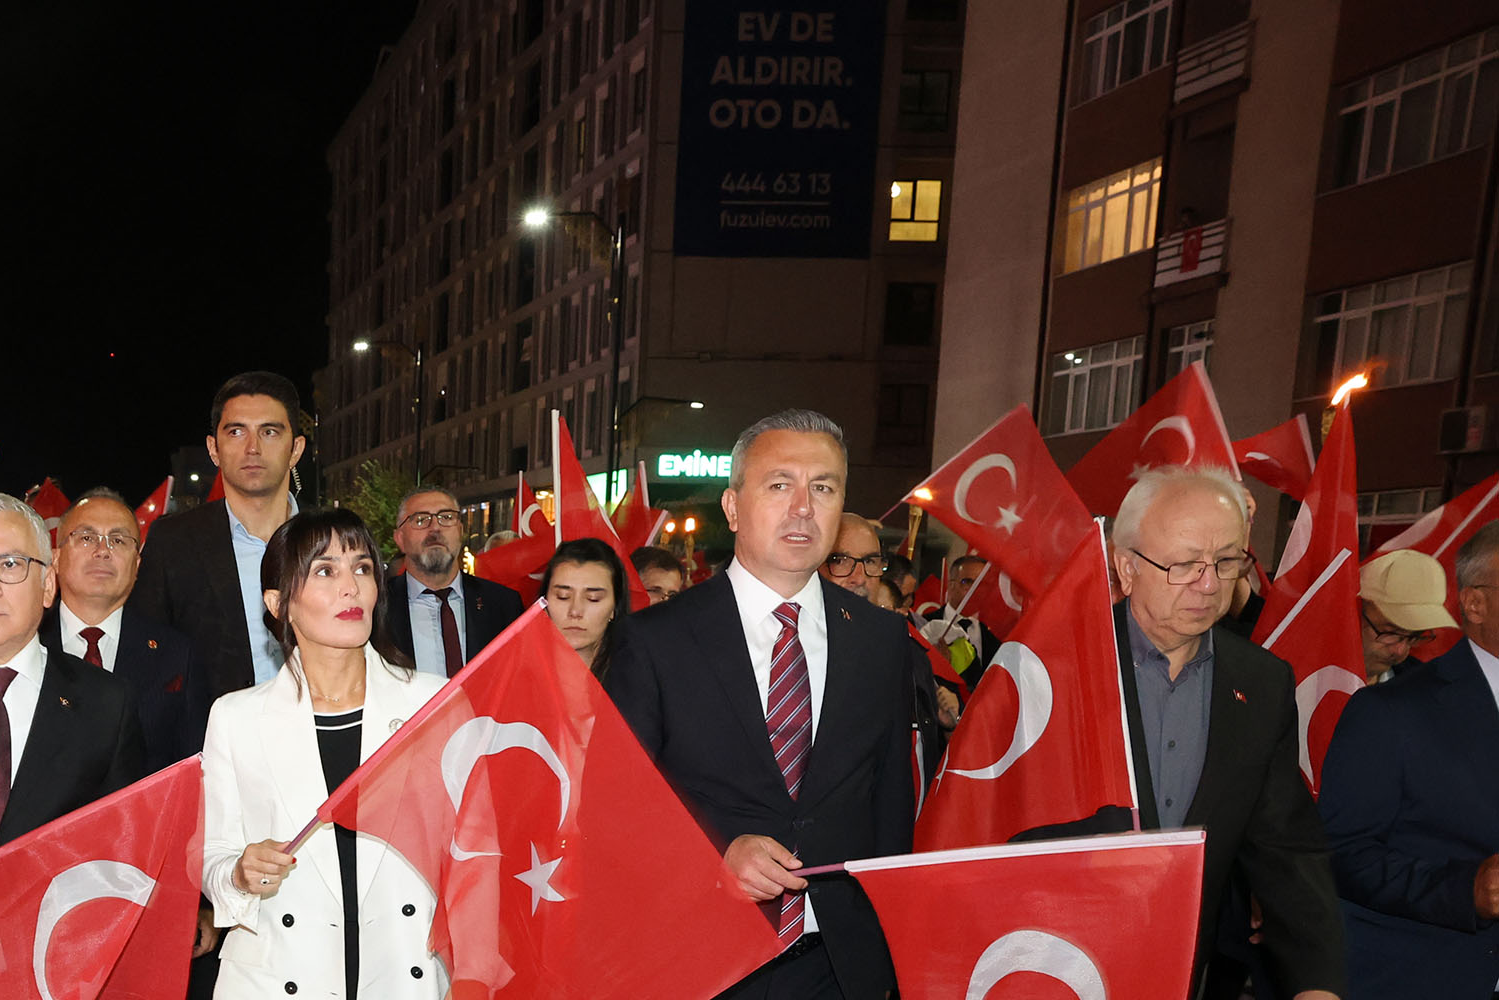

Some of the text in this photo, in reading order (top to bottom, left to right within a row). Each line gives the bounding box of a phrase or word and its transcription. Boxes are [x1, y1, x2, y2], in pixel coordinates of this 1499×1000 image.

[738, 11, 835, 42] EV DE
[710, 56, 852, 86] ALDIRIR.
[709, 99, 851, 128] OTO DA.
[721, 172, 832, 194] 444 63 13
[720, 210, 830, 228] fuzulev.com
